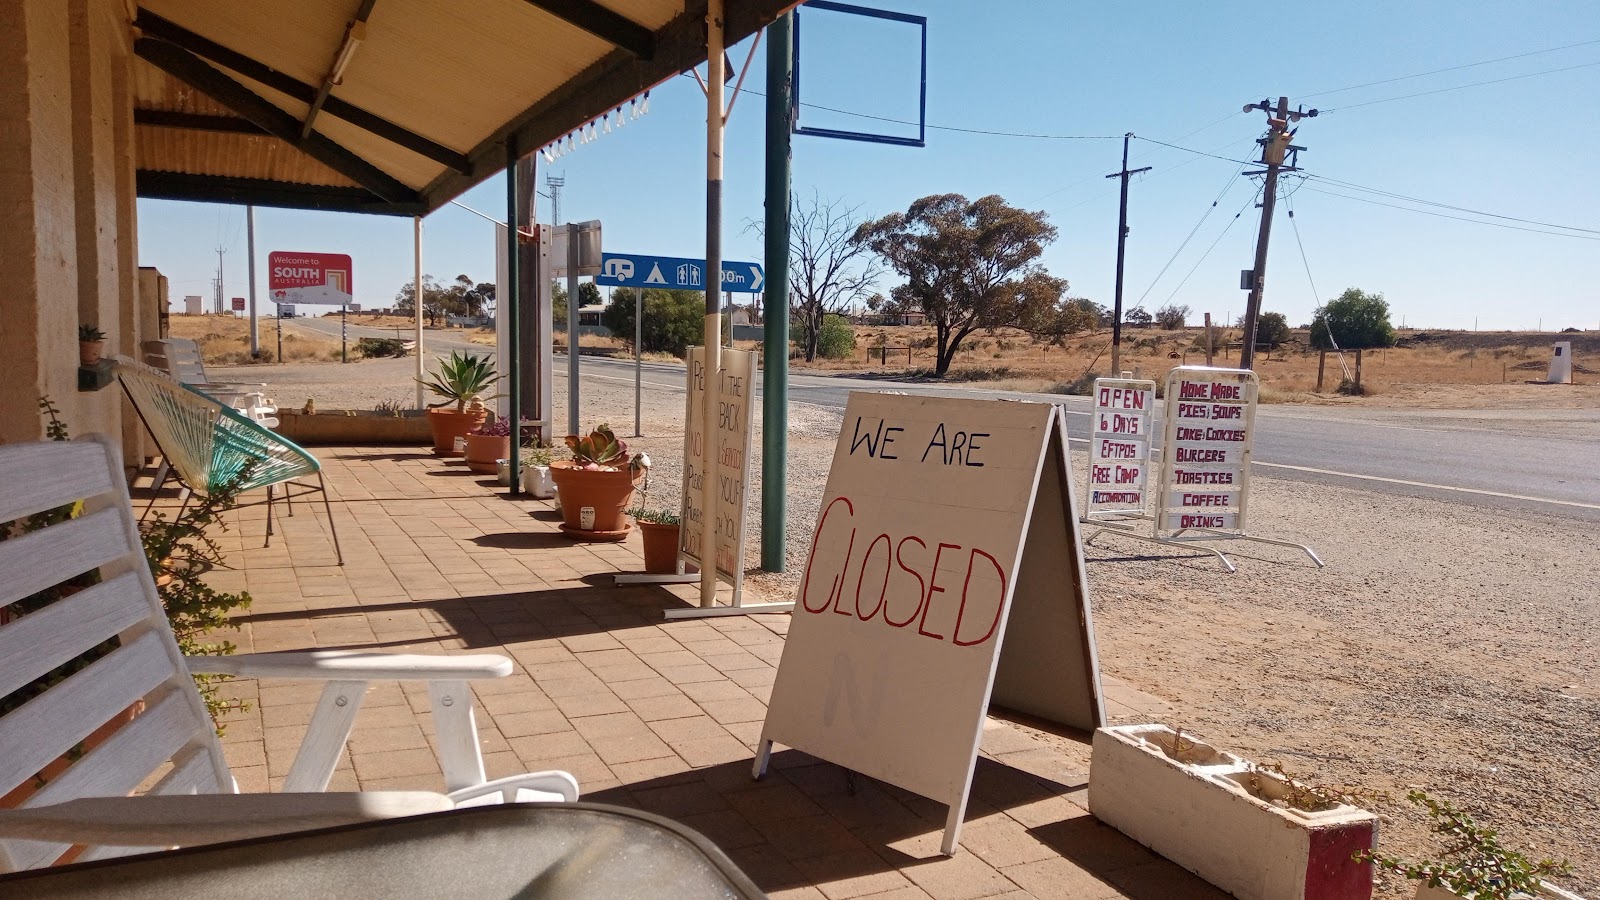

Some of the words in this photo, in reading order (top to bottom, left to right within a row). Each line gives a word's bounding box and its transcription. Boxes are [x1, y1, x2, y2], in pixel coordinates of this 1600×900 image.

[274, 256, 310, 265] Welcome
[274, 266, 320, 279] SOUTH
[728, 376, 742, 397] THE
[1180, 381, 1208, 398] HOME
[1211, 382, 1240, 399] MADE
[1099, 388, 1145, 409] OPEN
[719, 401, 740, 432] BACK
[1178, 403, 1206, 418] PIES
[1211, 404, 1242, 419] SOUPS
[1100, 413, 1108, 431] 6
[1113, 414, 1138, 434] DAYS
[850, 416, 904, 459] WE
[921, 423, 990, 467] ARE
[1176, 427, 1202, 440] CAKE
[1206, 427, 1246, 441] COOKIES
[1101, 439, 1136, 459] EFTPOS
[1176, 447, 1226, 463] BURGERS
[1091, 464, 1110, 483] FREE
[1114, 465, 1139, 484] CAMP
[1174, 469, 1233, 484] TOASTIES
[1183, 493, 1229, 506] COFFEE
[1181, 515, 1224, 528] DRINKS
[803, 496, 1006, 646] CLOSED
